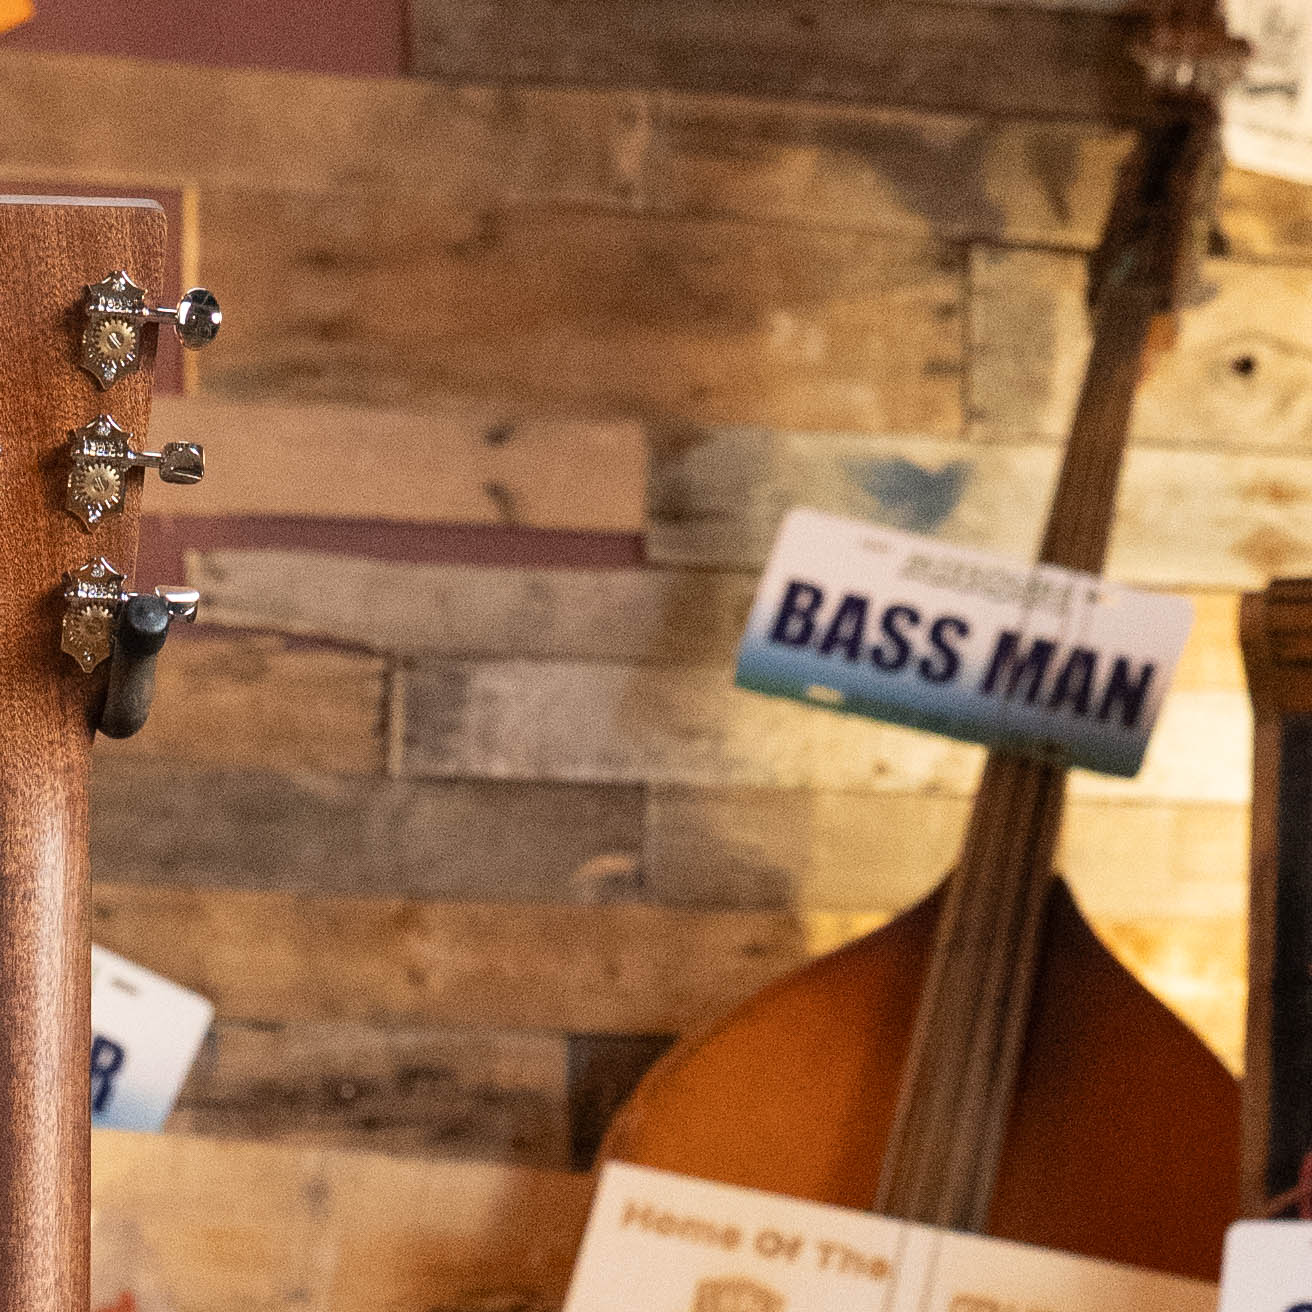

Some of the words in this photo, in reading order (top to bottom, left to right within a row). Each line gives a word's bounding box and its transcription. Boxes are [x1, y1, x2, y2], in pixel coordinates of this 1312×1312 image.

[768, 578, 971, 686] BASS
[980, 629, 1157, 729] MAN
[621, 1200, 743, 1253] Home
[816, 1238, 892, 1280] The
